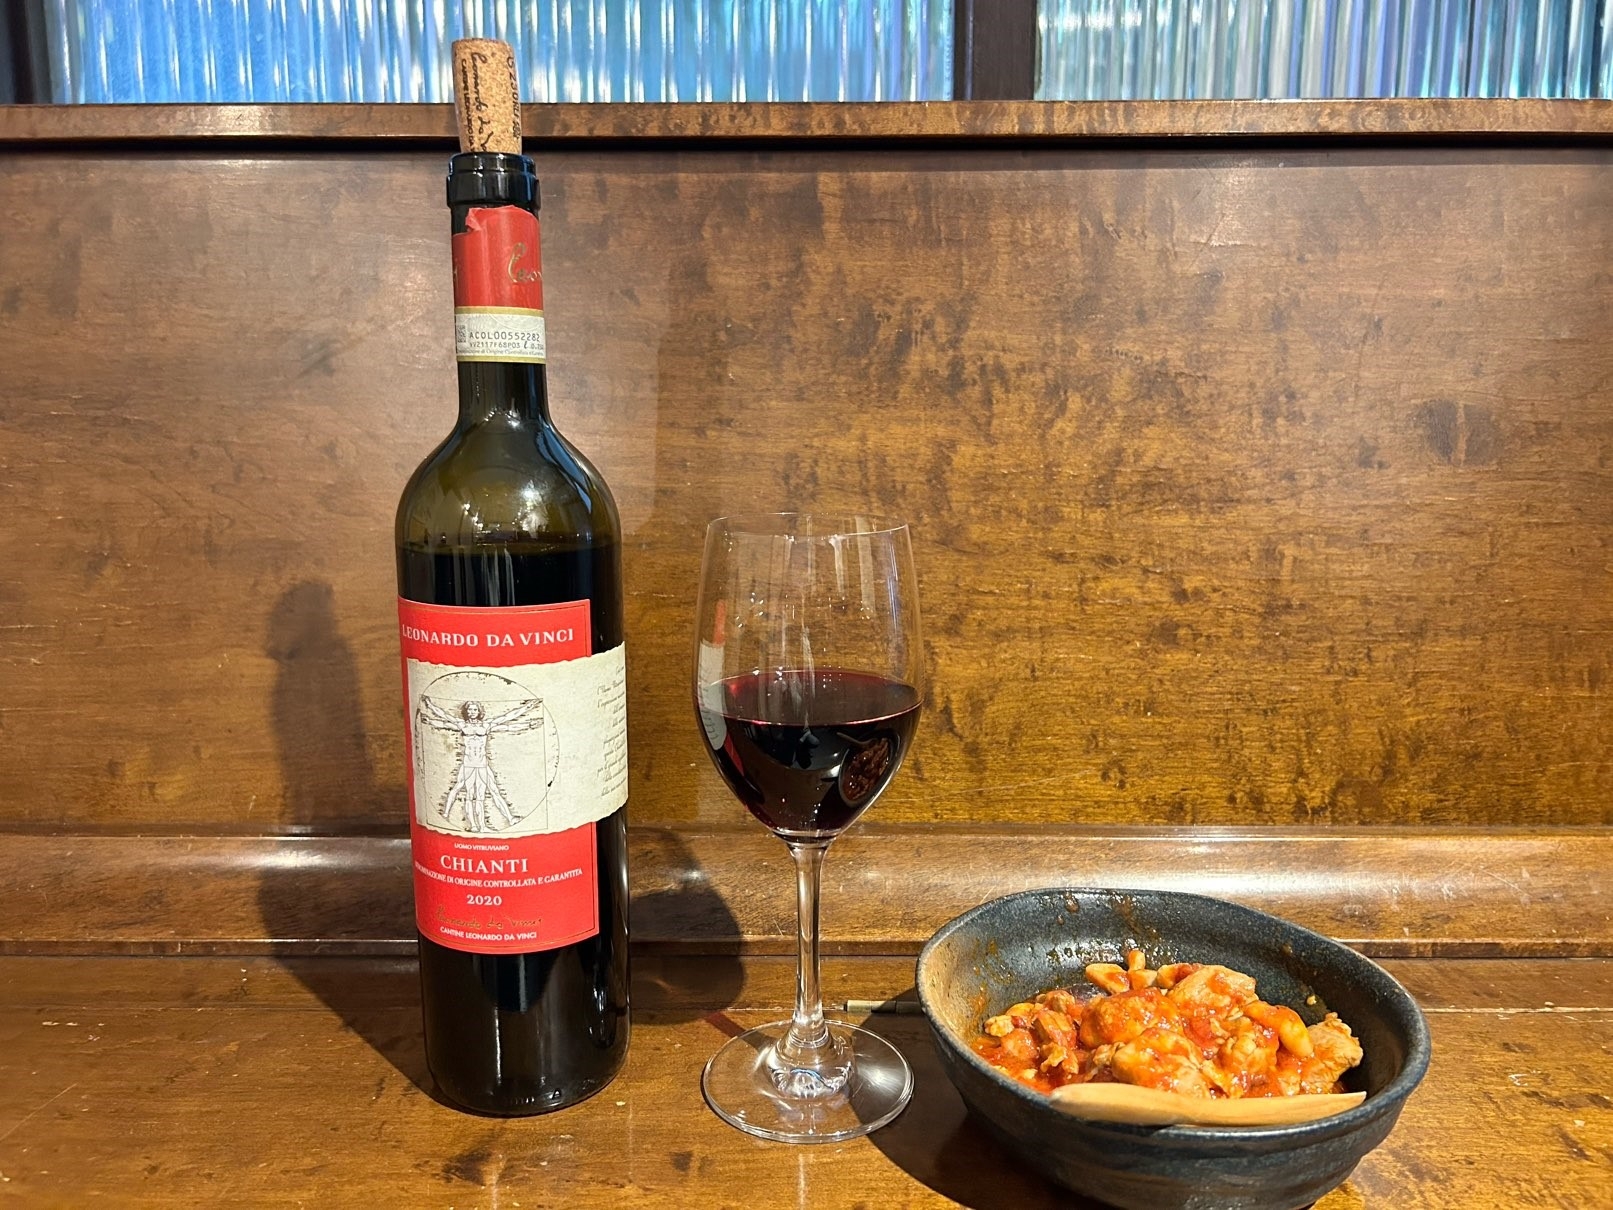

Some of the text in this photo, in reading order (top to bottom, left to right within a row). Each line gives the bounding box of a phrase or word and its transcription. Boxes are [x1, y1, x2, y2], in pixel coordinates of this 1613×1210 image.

[402, 624, 574, 648] LEONARDO DA VINCI
[440, 854, 528, 875] CHIANTI
[447, 875, 454, 884] DI
[454, 877, 483, 888] ORIGINE
[483, 878, 537, 888] CONTROLLATA
[544, 868, 583, 884] GARANTITA
[466, 894, 503, 906] 2020
[440, 926, 537, 941] CANTINE LEONARDO DA VINCI
